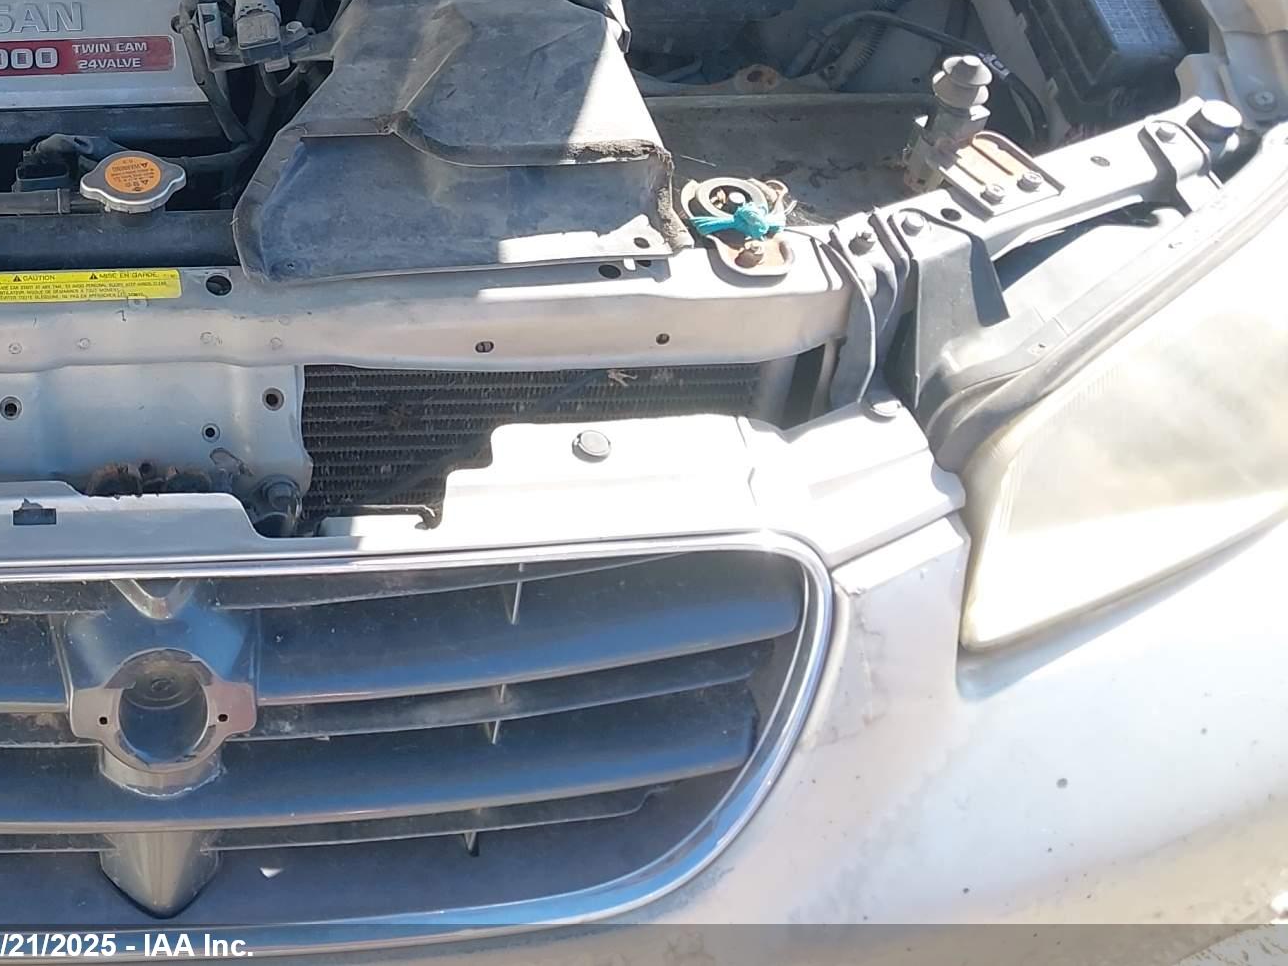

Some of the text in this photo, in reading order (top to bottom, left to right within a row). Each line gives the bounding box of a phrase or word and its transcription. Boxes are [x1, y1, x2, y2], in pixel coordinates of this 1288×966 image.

[72, 41, 148, 54] TWIN CAM
[78, 57, 142, 70] 24VALVE
